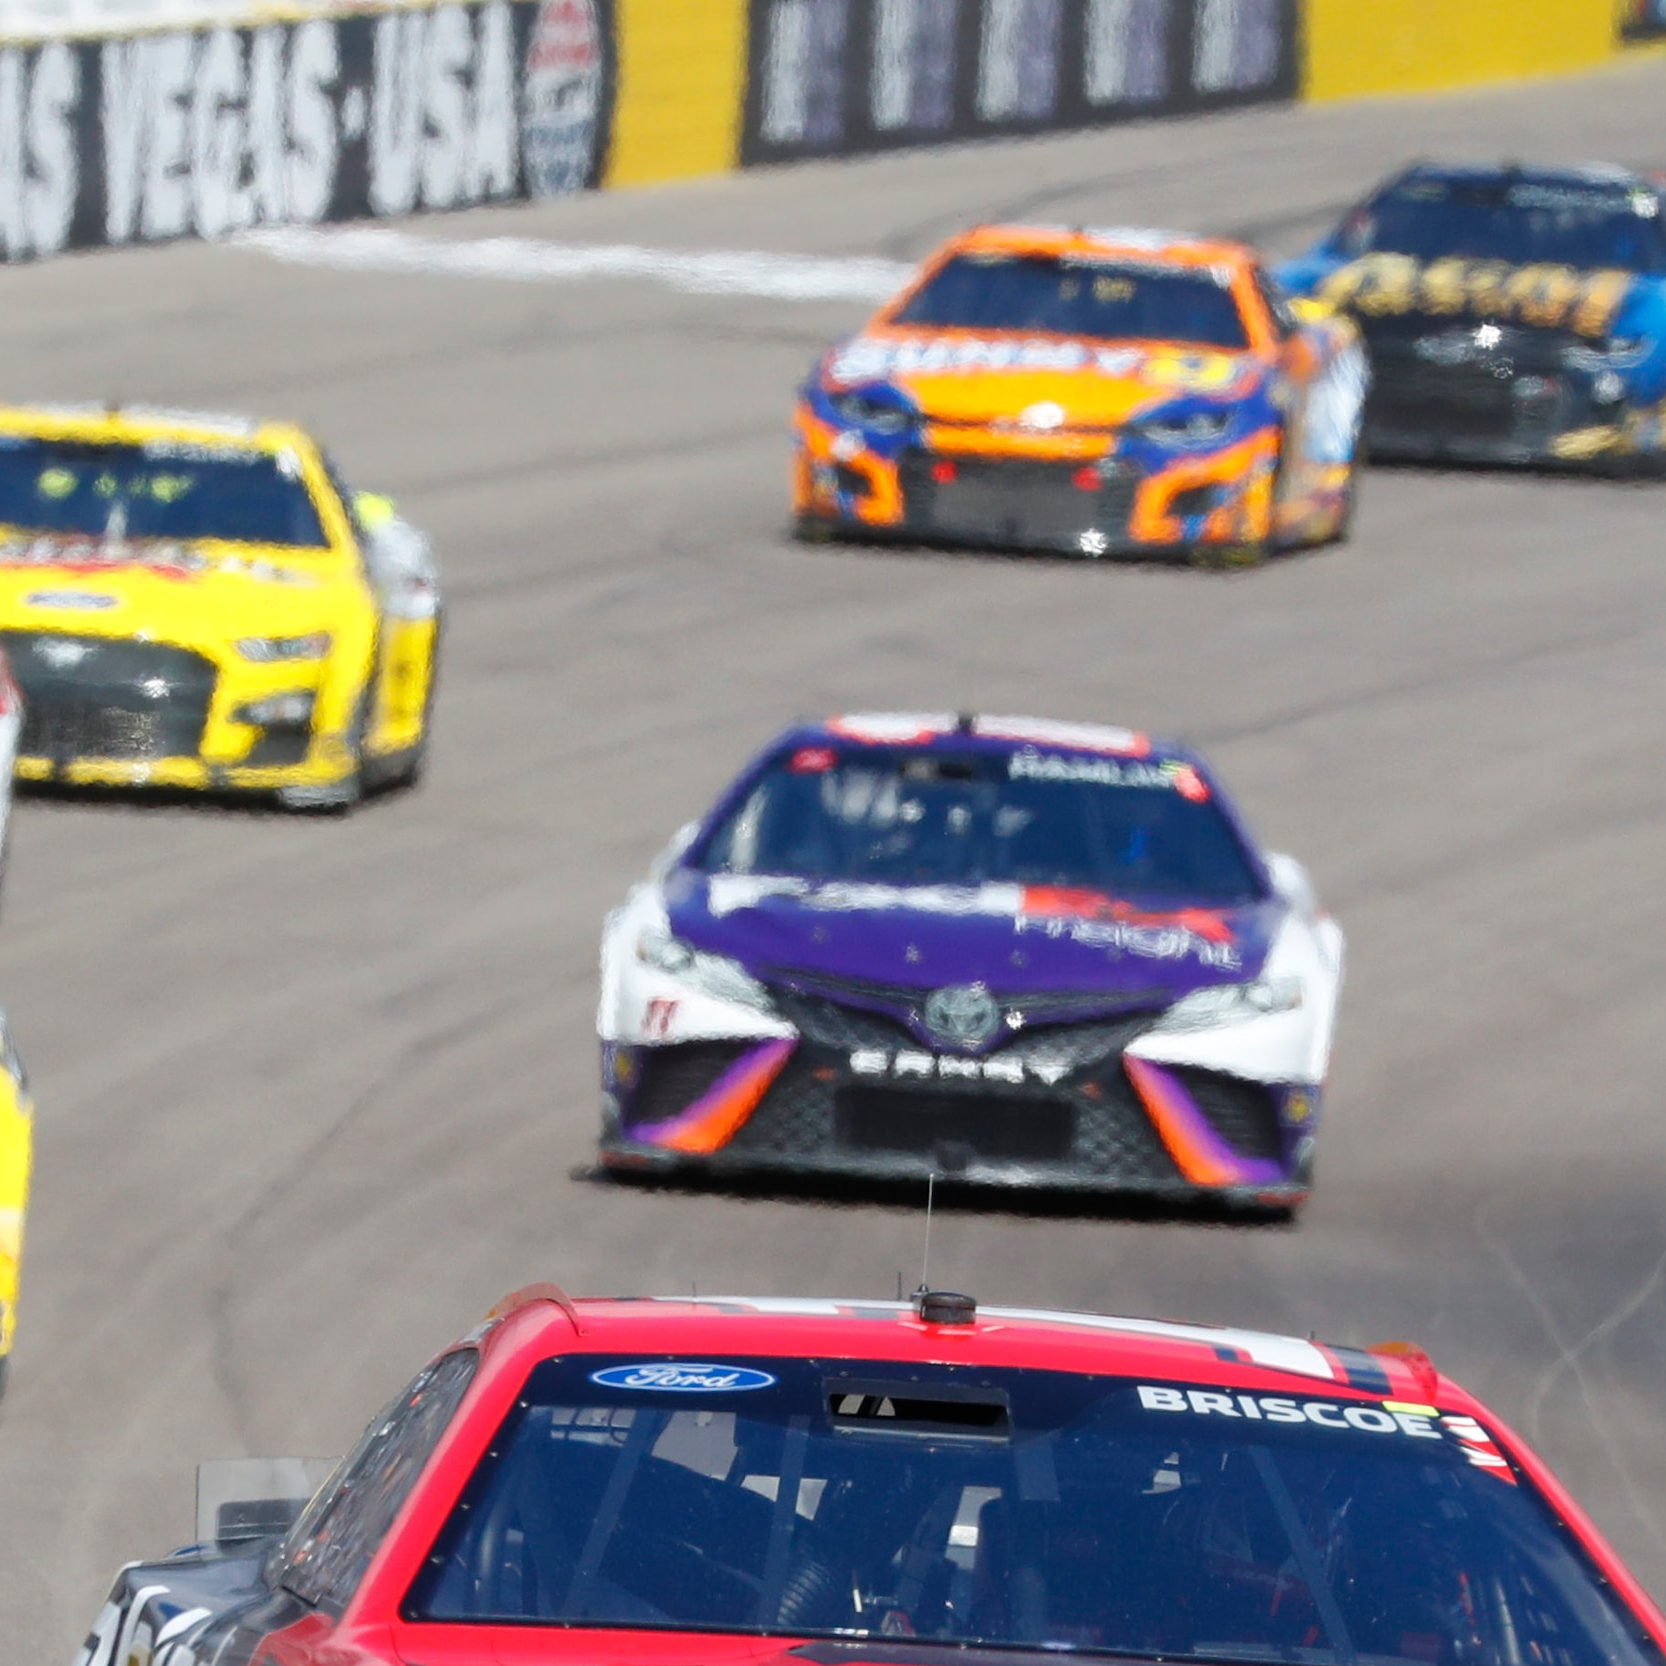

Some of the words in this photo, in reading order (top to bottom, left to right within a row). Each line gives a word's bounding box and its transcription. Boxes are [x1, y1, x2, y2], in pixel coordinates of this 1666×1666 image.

[103, 19, 339, 247] VEGAS
[624, 1365, 741, 1389] Ford
[1137, 1385, 1443, 1440] BRISCOE
